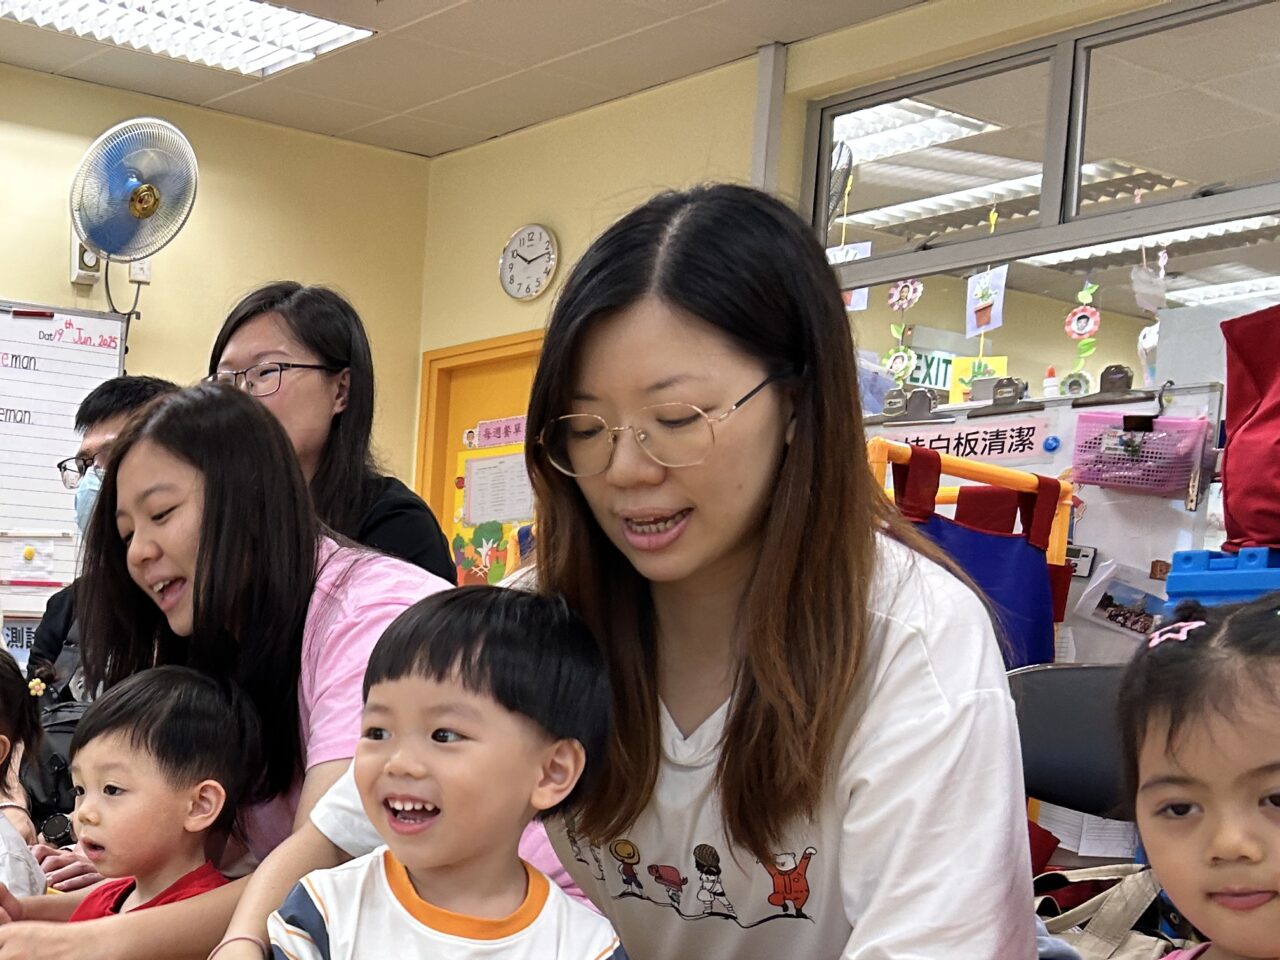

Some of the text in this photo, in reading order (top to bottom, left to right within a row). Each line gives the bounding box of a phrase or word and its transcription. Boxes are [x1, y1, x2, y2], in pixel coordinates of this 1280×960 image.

[528, 232, 535, 242] 12
[545, 240, 550, 251] 2
[508, 263, 514, 273] 9
[543, 266, 551, 276] 4
[509, 274, 515, 285] 8
[517, 283, 523, 293] 7
[525, 284, 531, 294] 6
[98, 334, 118, 349] 2025
[909, 353, 952, 387] EXIT
